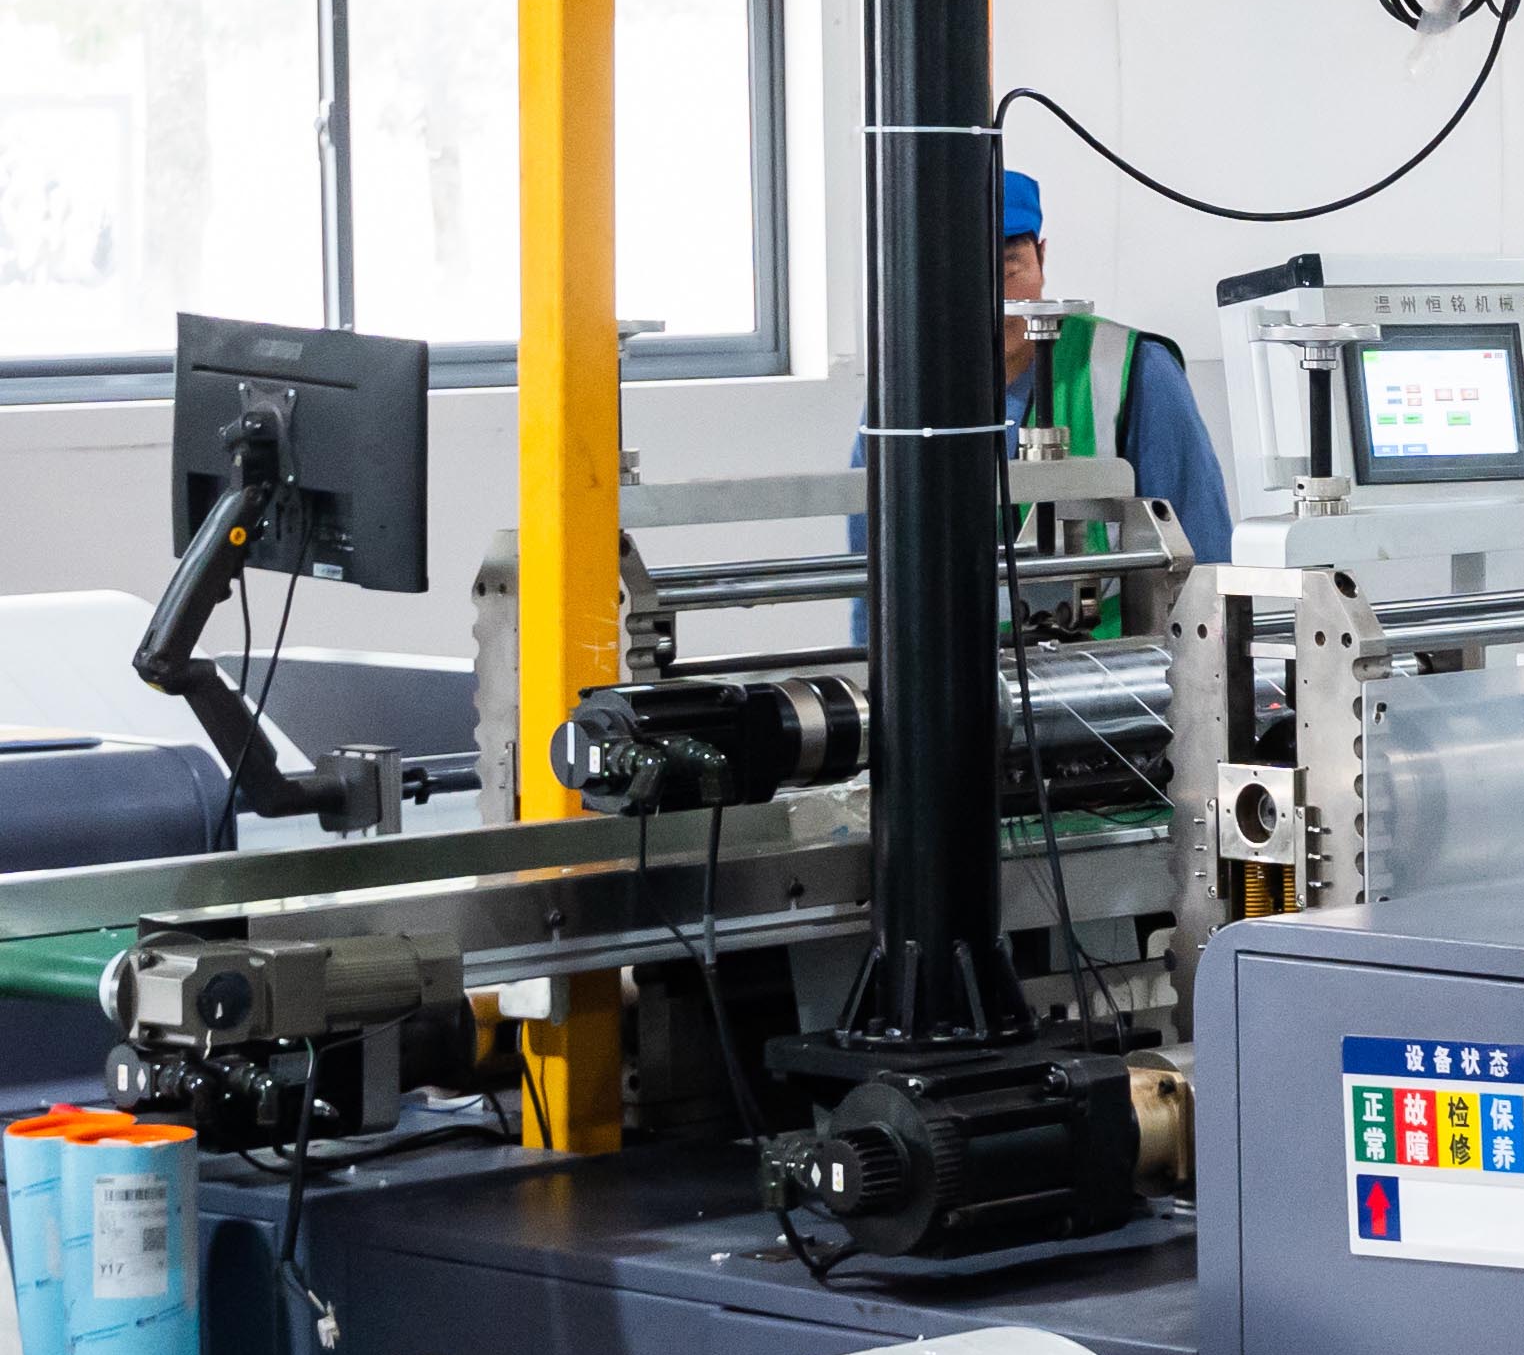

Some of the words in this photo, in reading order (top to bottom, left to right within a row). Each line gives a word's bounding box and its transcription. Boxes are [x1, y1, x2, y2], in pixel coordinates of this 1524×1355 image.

[1404, 1044, 1510, 1078] 设备状态
[1362, 1091, 1387, 1161] 正常
[1403, 1092, 1430, 1165] 故障
[1447, 1095, 1472, 1166] 检修
[1489, 1097, 1516, 1171] 保养
